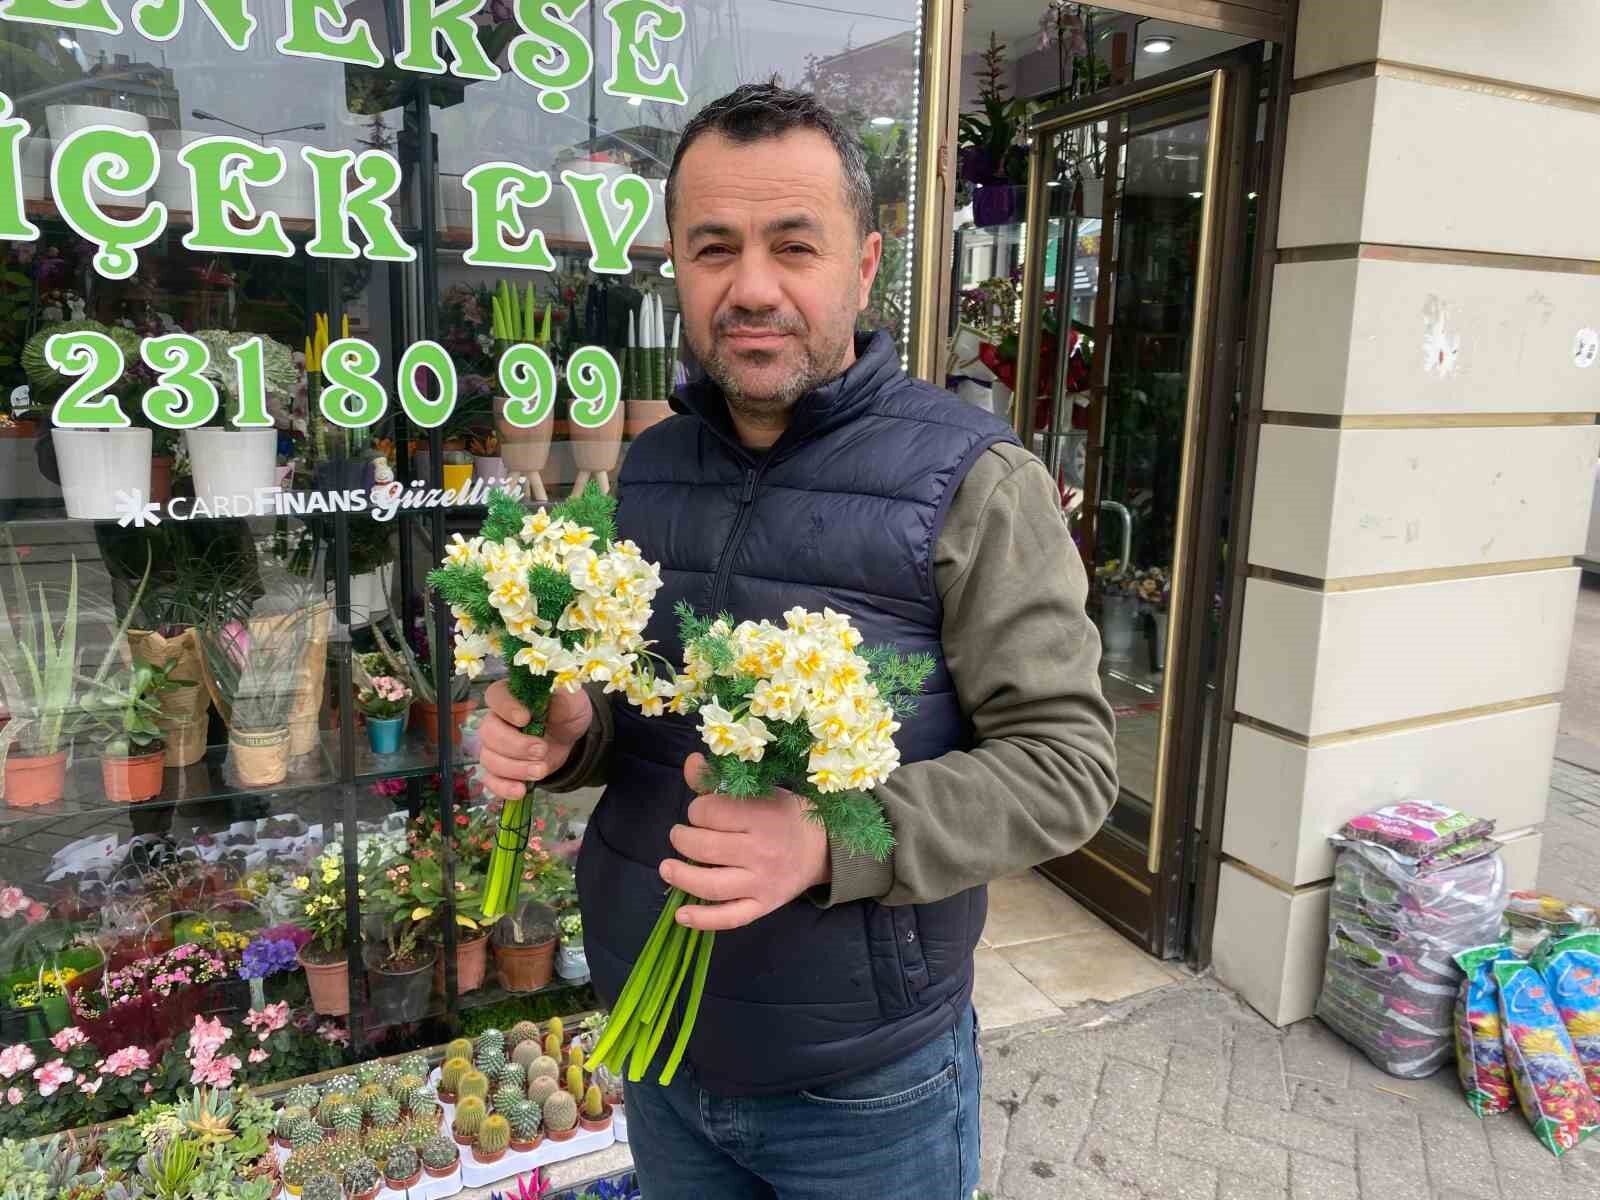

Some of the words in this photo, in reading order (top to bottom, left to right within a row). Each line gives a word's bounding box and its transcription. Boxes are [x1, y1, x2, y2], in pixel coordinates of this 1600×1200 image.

[462, 161, 674, 278] EV
[45, 331, 275, 429] 231
[319, 337, 458, 429] 80
[498, 343, 622, 428] 99
